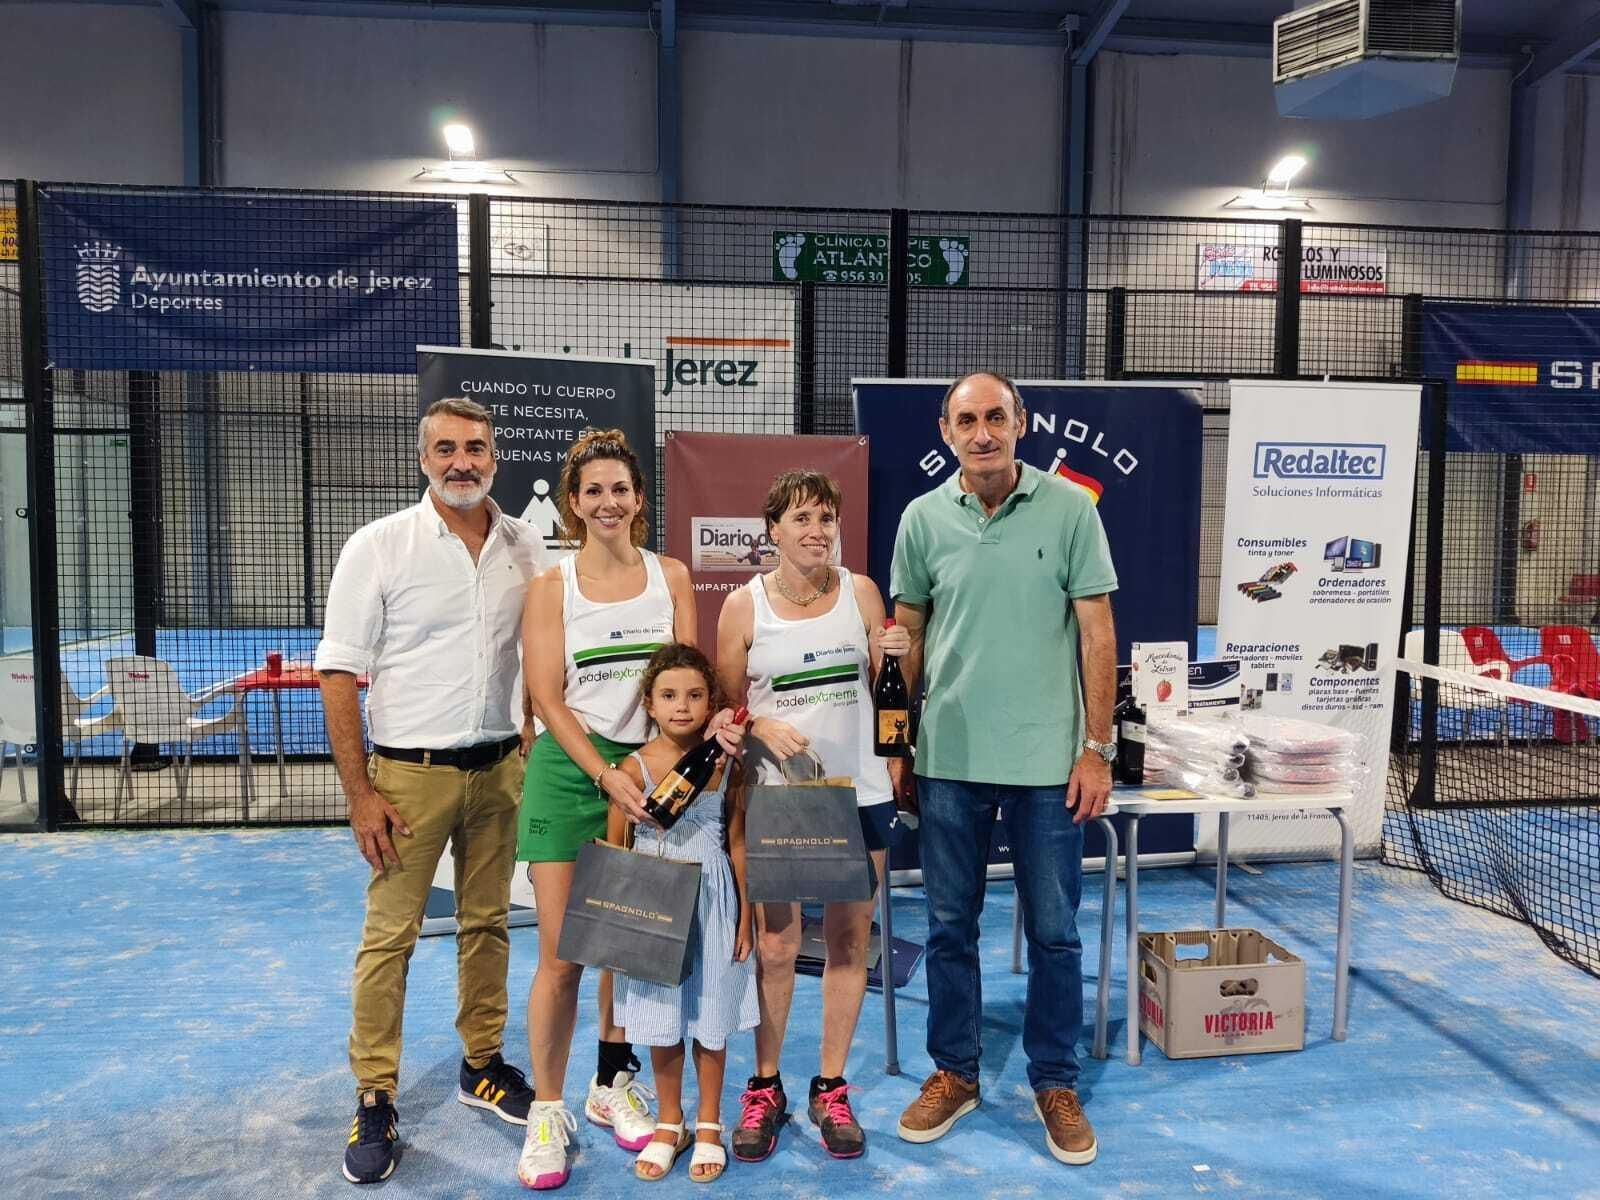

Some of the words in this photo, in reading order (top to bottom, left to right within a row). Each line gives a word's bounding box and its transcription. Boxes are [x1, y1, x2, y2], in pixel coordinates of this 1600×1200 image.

[814, 235, 872, 247] CLÍNICA
[1331, 248, 1340, 262] Y
[130, 265, 321, 291] Ayuntamiento
[328, 269, 359, 289] de
[1304, 265, 1383, 281] LUMINOSOS
[131, 292, 224, 314] Deportes
[663, 348, 759, 395] Jerez
[460, 381, 527, 395] CUANDO
[532, 384, 551, 396] TU
[556, 385, 616, 400] CUERPO
[490, 404, 509, 416] TE
[514, 406, 589, 422] NECESITA,
[494, 426, 573, 441] PORTANTE
[1264, 447, 1377, 478] Redaltec
[1252, 486, 1313, 498] Soluciones
[1315, 486, 1383, 499] Informáticas
[700, 528, 753, 546] Diario
[1237, 537, 1308, 548] Consumibles
[1267, 550, 1273, 558] y
[1318, 577, 1387, 588] Ordenadores
[1226, 642, 1300, 654] Reparaciones
[1310, 677, 1380, 688] Componentes
[776, 837, 832, 845] SPAGNOLO
[1204, 1011, 1274, 1034] VICTORIA
